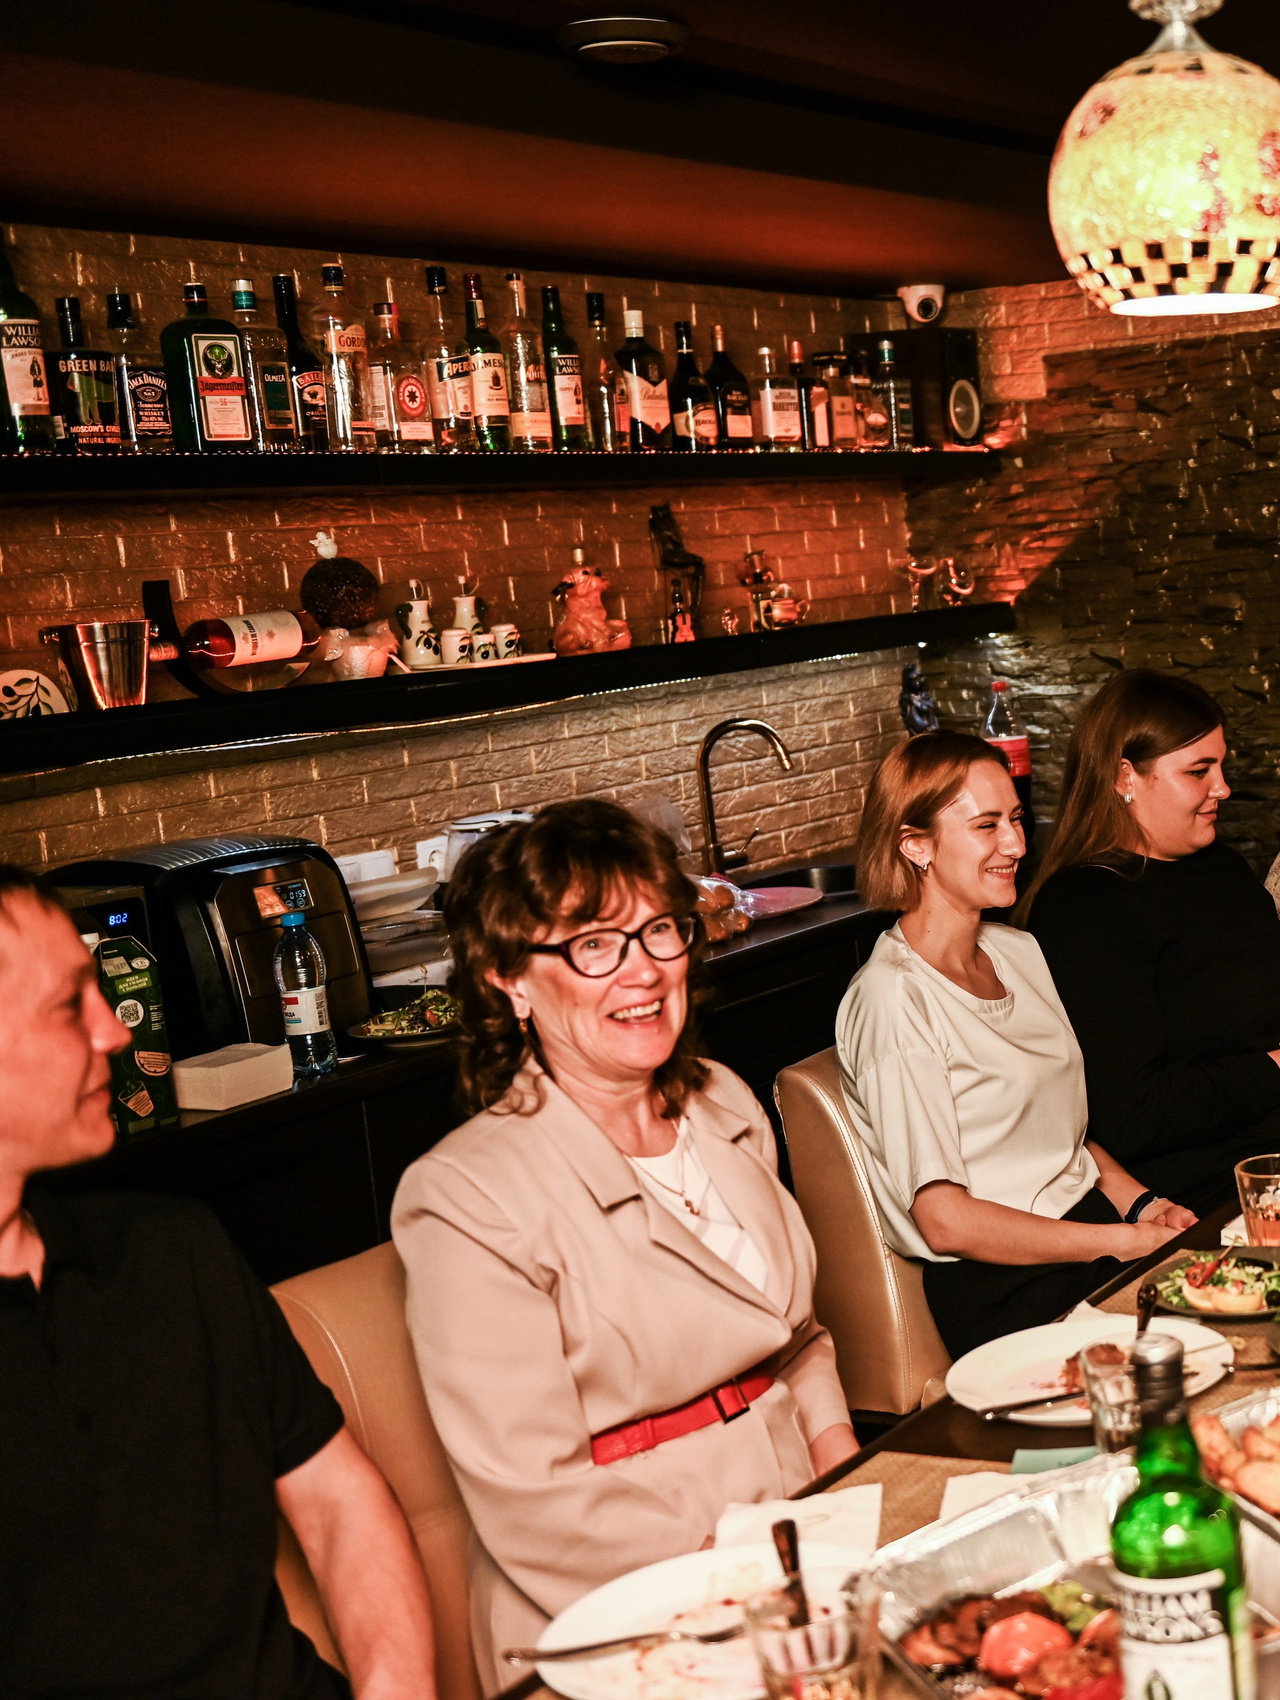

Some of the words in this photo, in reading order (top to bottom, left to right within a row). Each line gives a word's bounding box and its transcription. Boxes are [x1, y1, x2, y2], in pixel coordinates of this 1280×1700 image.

[58, 359, 97, 373] GREEN
[128, 376, 144, 390] JACK
[264, 373, 285, 383] OLMECA
[218, 397, 229, 407] 56
[69, 424, 105, 434] MOSCOW'S
[78, 437, 105, 445] NATURAL
